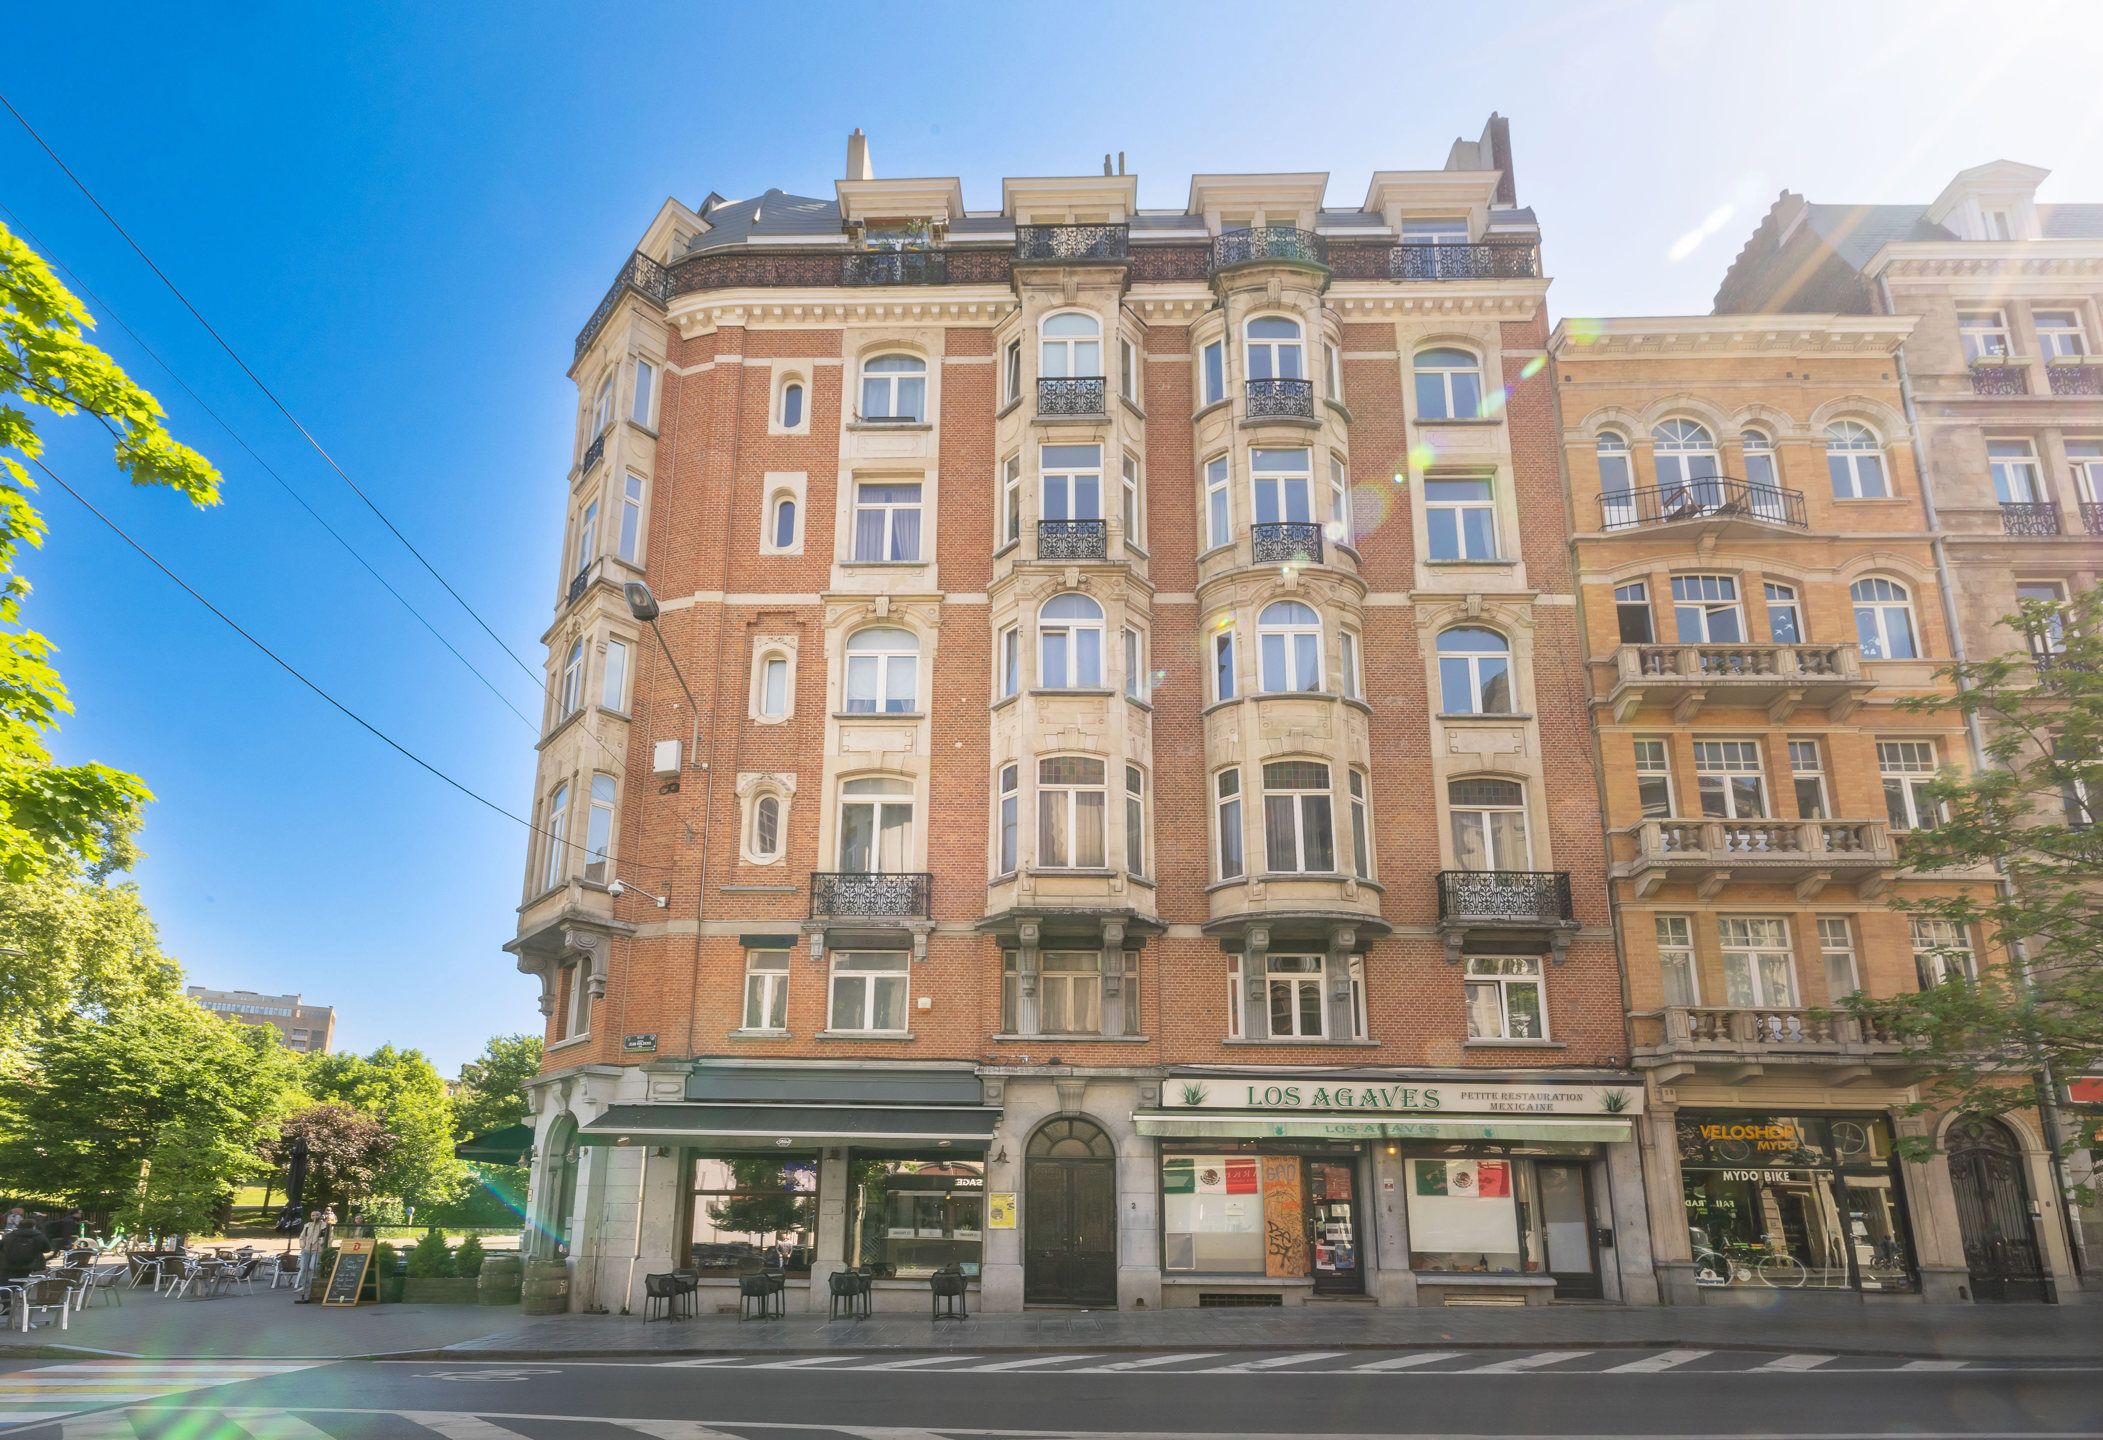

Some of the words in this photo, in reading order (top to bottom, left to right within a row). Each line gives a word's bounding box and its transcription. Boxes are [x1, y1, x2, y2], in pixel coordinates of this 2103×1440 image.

[1247, 1086, 1301, 1106] LOS
[1312, 1085, 1441, 1109] AGAVES
[1461, 1091, 1498, 1100] PETITE
[1501, 1092, 1583, 1101] RESTAURATION
[1490, 1102, 1554, 1111] MEXICAINE
[1325, 1125, 1358, 1133] LOS
[1700, 1124, 1795, 1140] VELOSHOP
[1757, 1140, 1798, 1151] MYDO
[1723, 1170, 1759, 1181] MYDO
[1764, 1171, 1791, 1182] BIKE
[1131, 1202, 1137, 1210] 2
